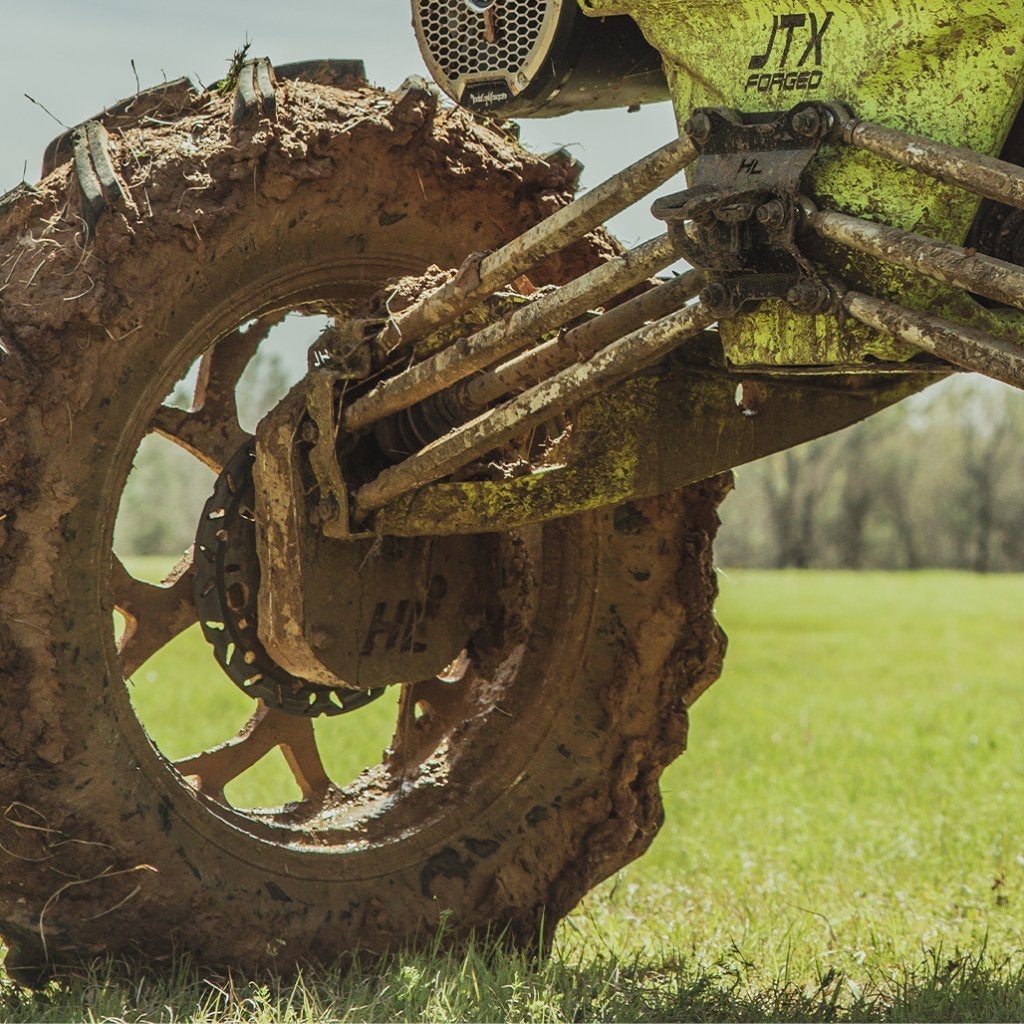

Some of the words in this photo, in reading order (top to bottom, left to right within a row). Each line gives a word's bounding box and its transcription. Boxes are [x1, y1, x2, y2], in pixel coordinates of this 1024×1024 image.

[748, 12, 834, 69] JTX
[744, 70, 823, 93] FORGED
[737, 158, 761, 175] HL
